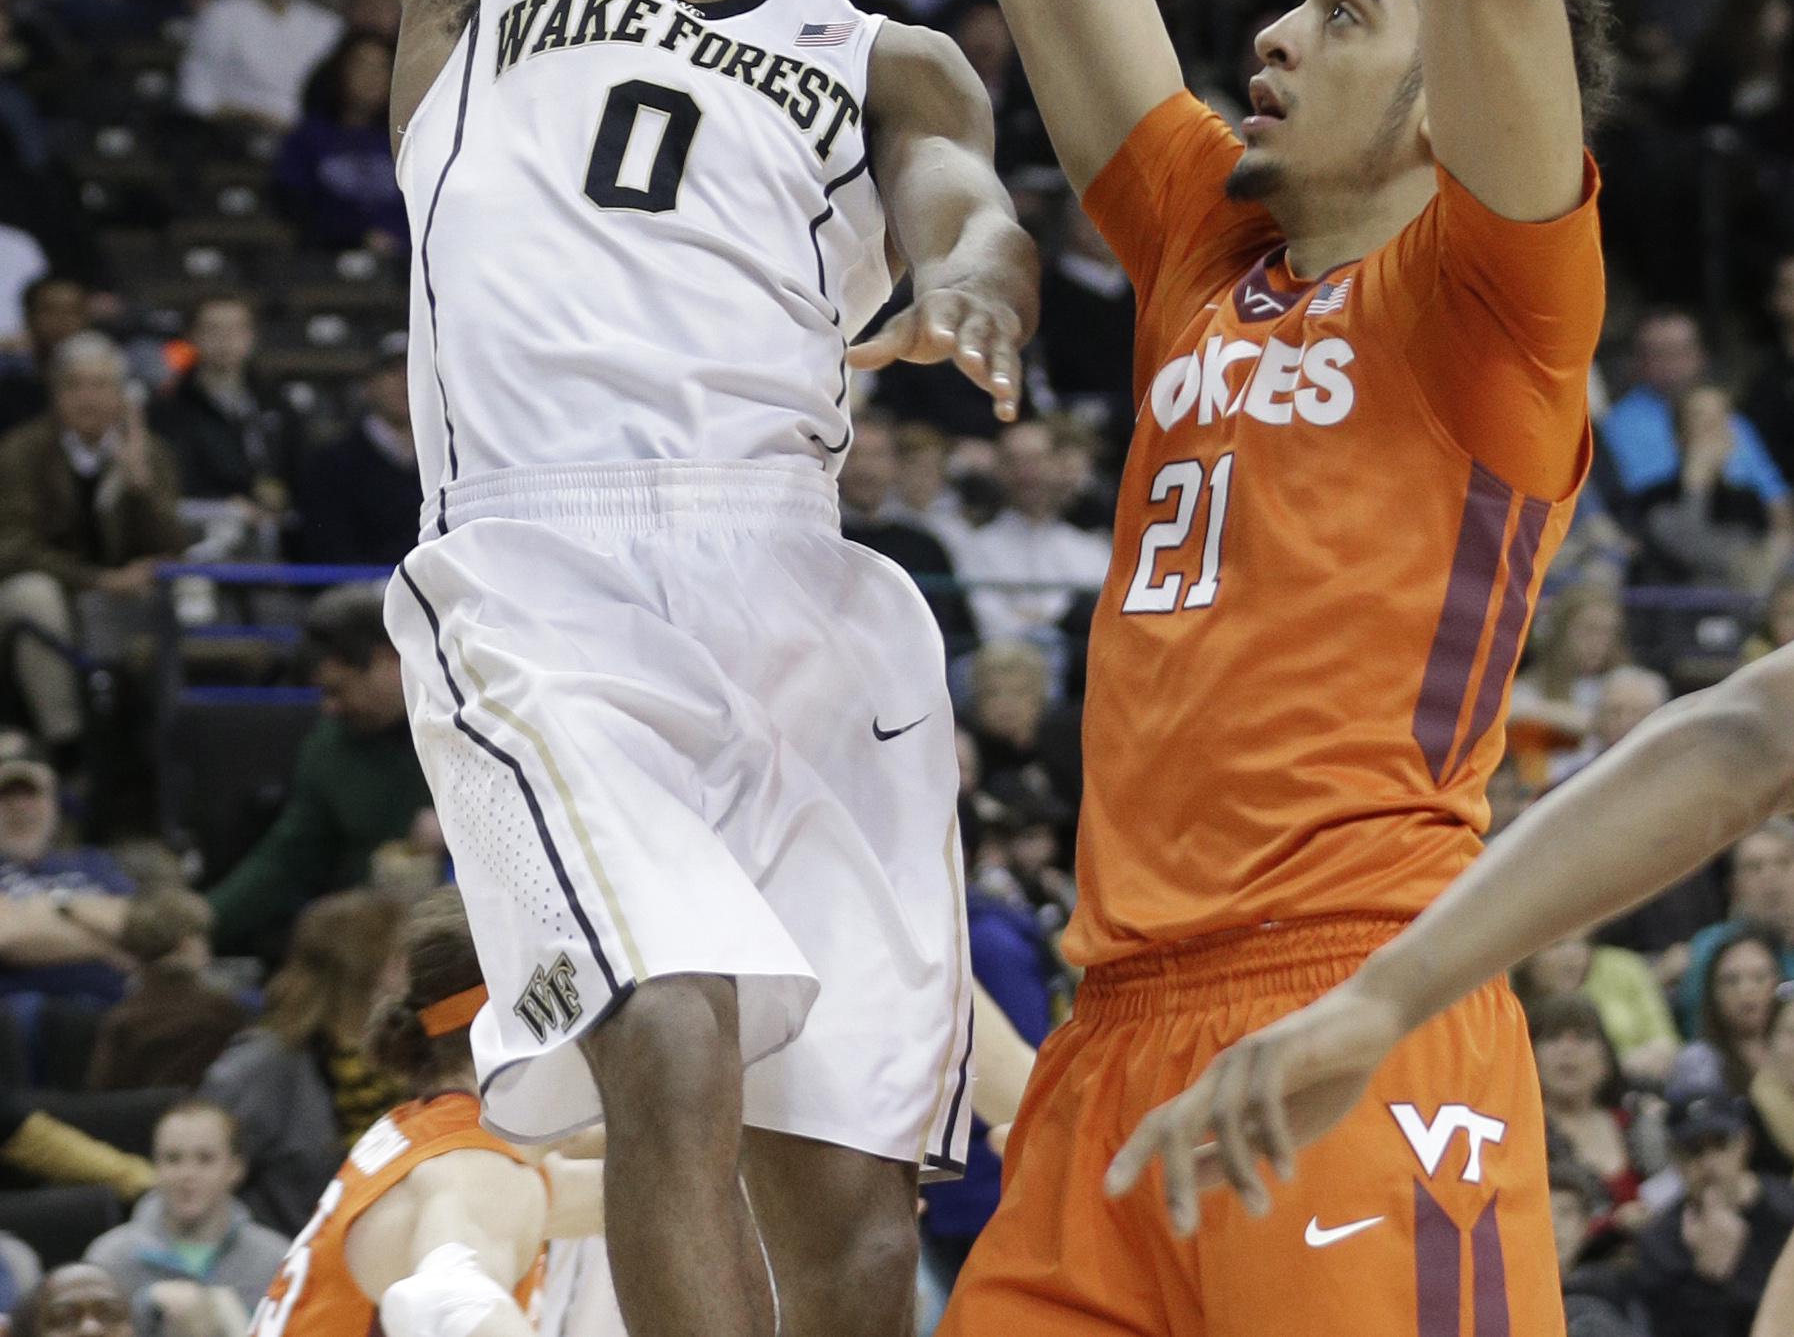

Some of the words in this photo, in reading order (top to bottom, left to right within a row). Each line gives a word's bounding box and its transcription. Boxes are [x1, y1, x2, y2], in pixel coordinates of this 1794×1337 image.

[582, 78, 703, 215] 0
[654, 10, 861, 169] FOREST
[1244, 285, 1285, 314] VT
[1121, 451, 1234, 614] 21
[512, 950, 583, 1045] WF
[1385, 1101, 1507, 1184] VT
